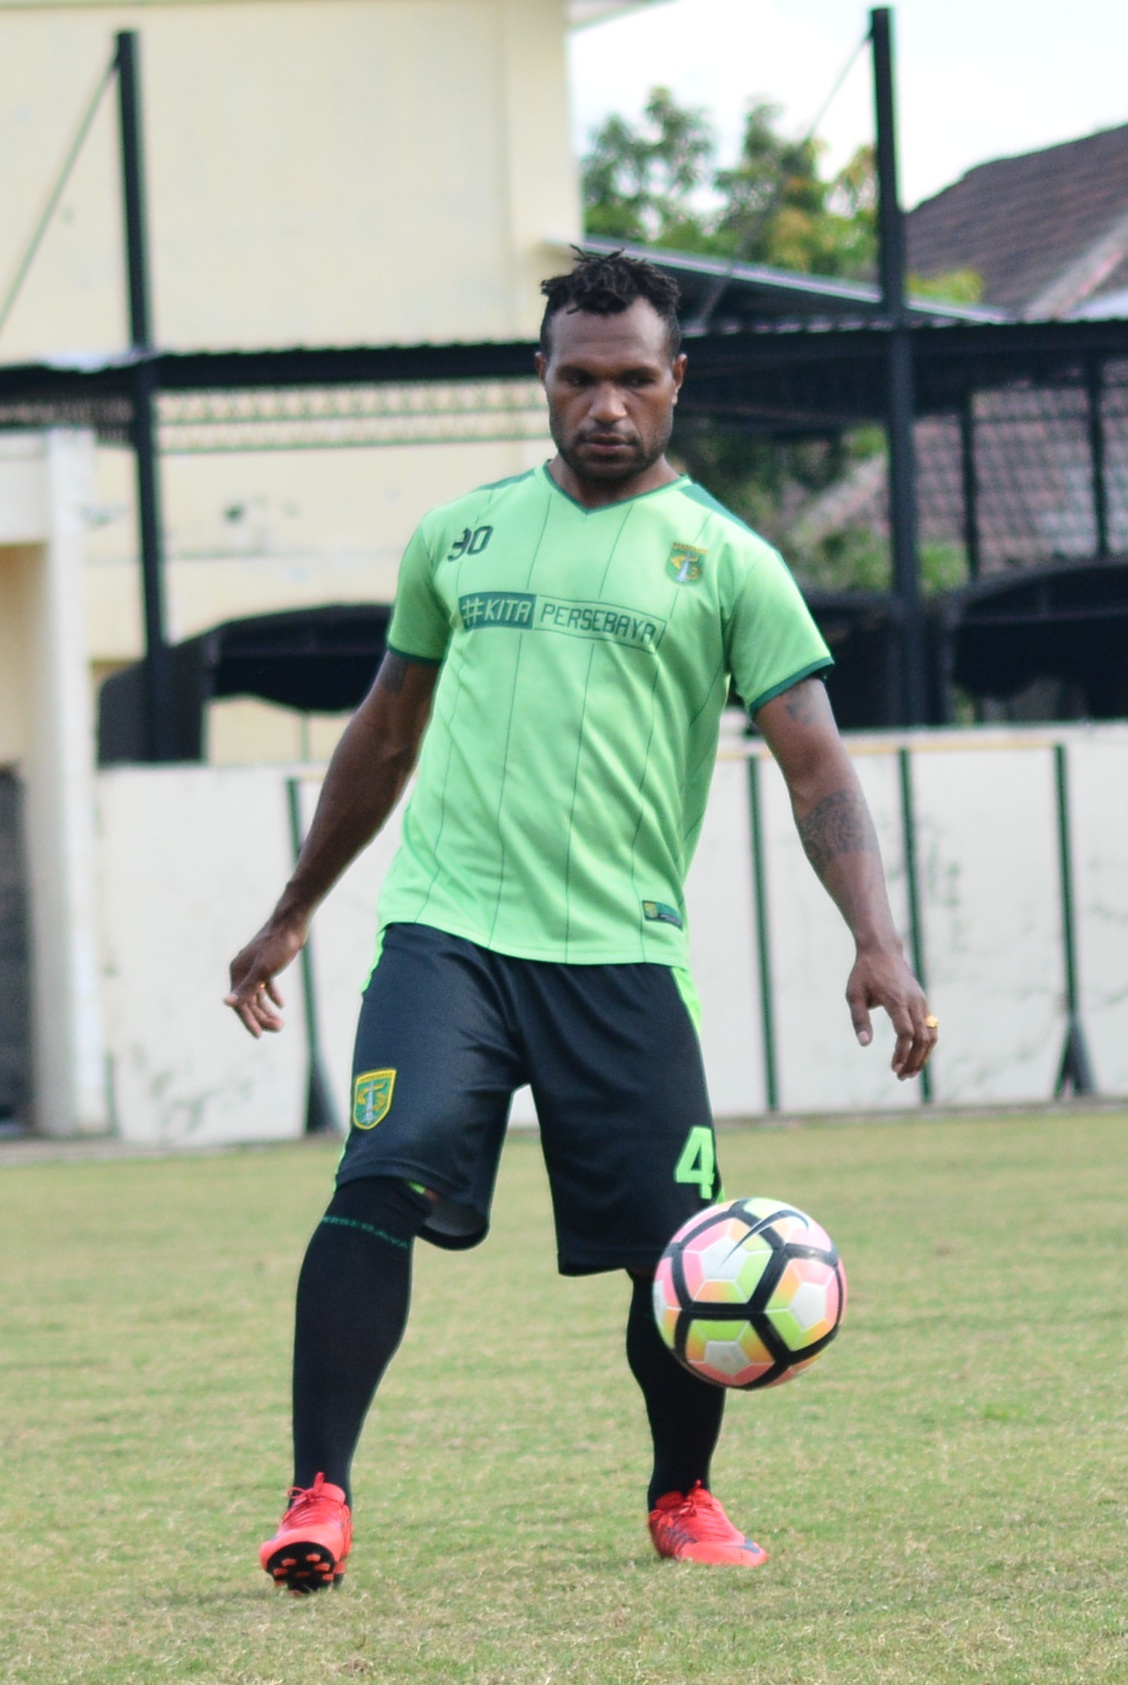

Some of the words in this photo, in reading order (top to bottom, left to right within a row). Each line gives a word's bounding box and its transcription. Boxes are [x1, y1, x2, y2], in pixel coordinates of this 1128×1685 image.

[462, 597, 531, 627] #KITA
[540, 602, 658, 643] PERSEBAYA
[674, 1126, 715, 1200] 4
